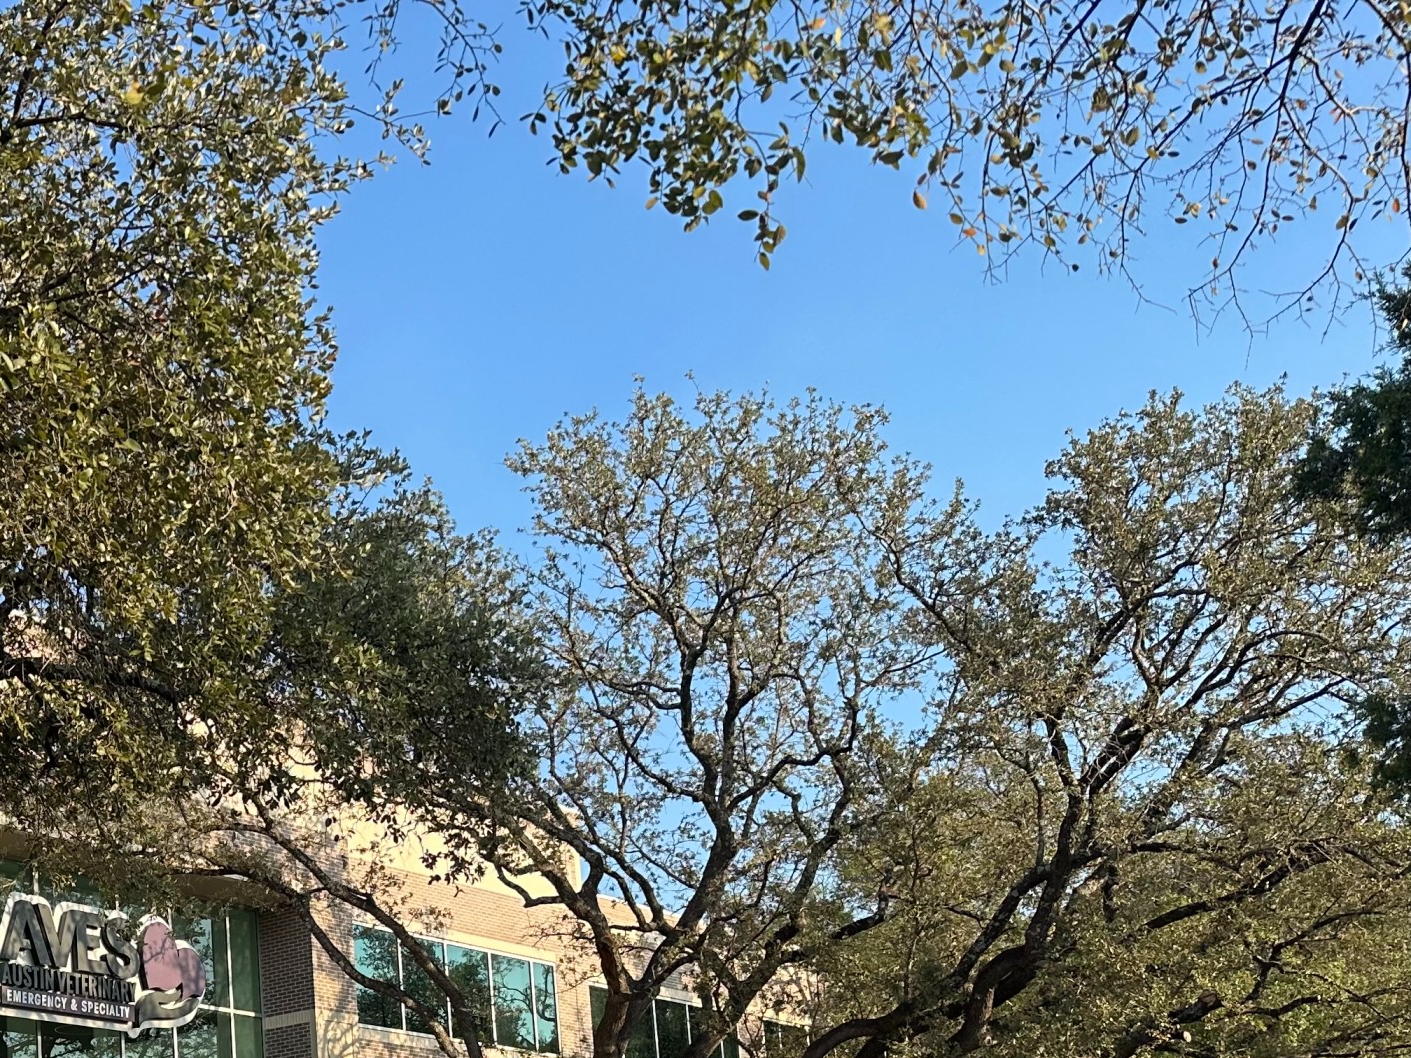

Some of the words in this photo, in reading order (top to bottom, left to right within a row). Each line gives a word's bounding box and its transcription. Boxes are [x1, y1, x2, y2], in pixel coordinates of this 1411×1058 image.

[0, 900, 140, 979] AVES
[2, 962, 55, 992] AUSTIN
[57, 969, 137, 1002] VETERINARY
[6, 989, 68, 1009] EMERGENCY
[70, 998, 78, 1011] &
[81, 1000, 130, 1018] SPECIALTY
